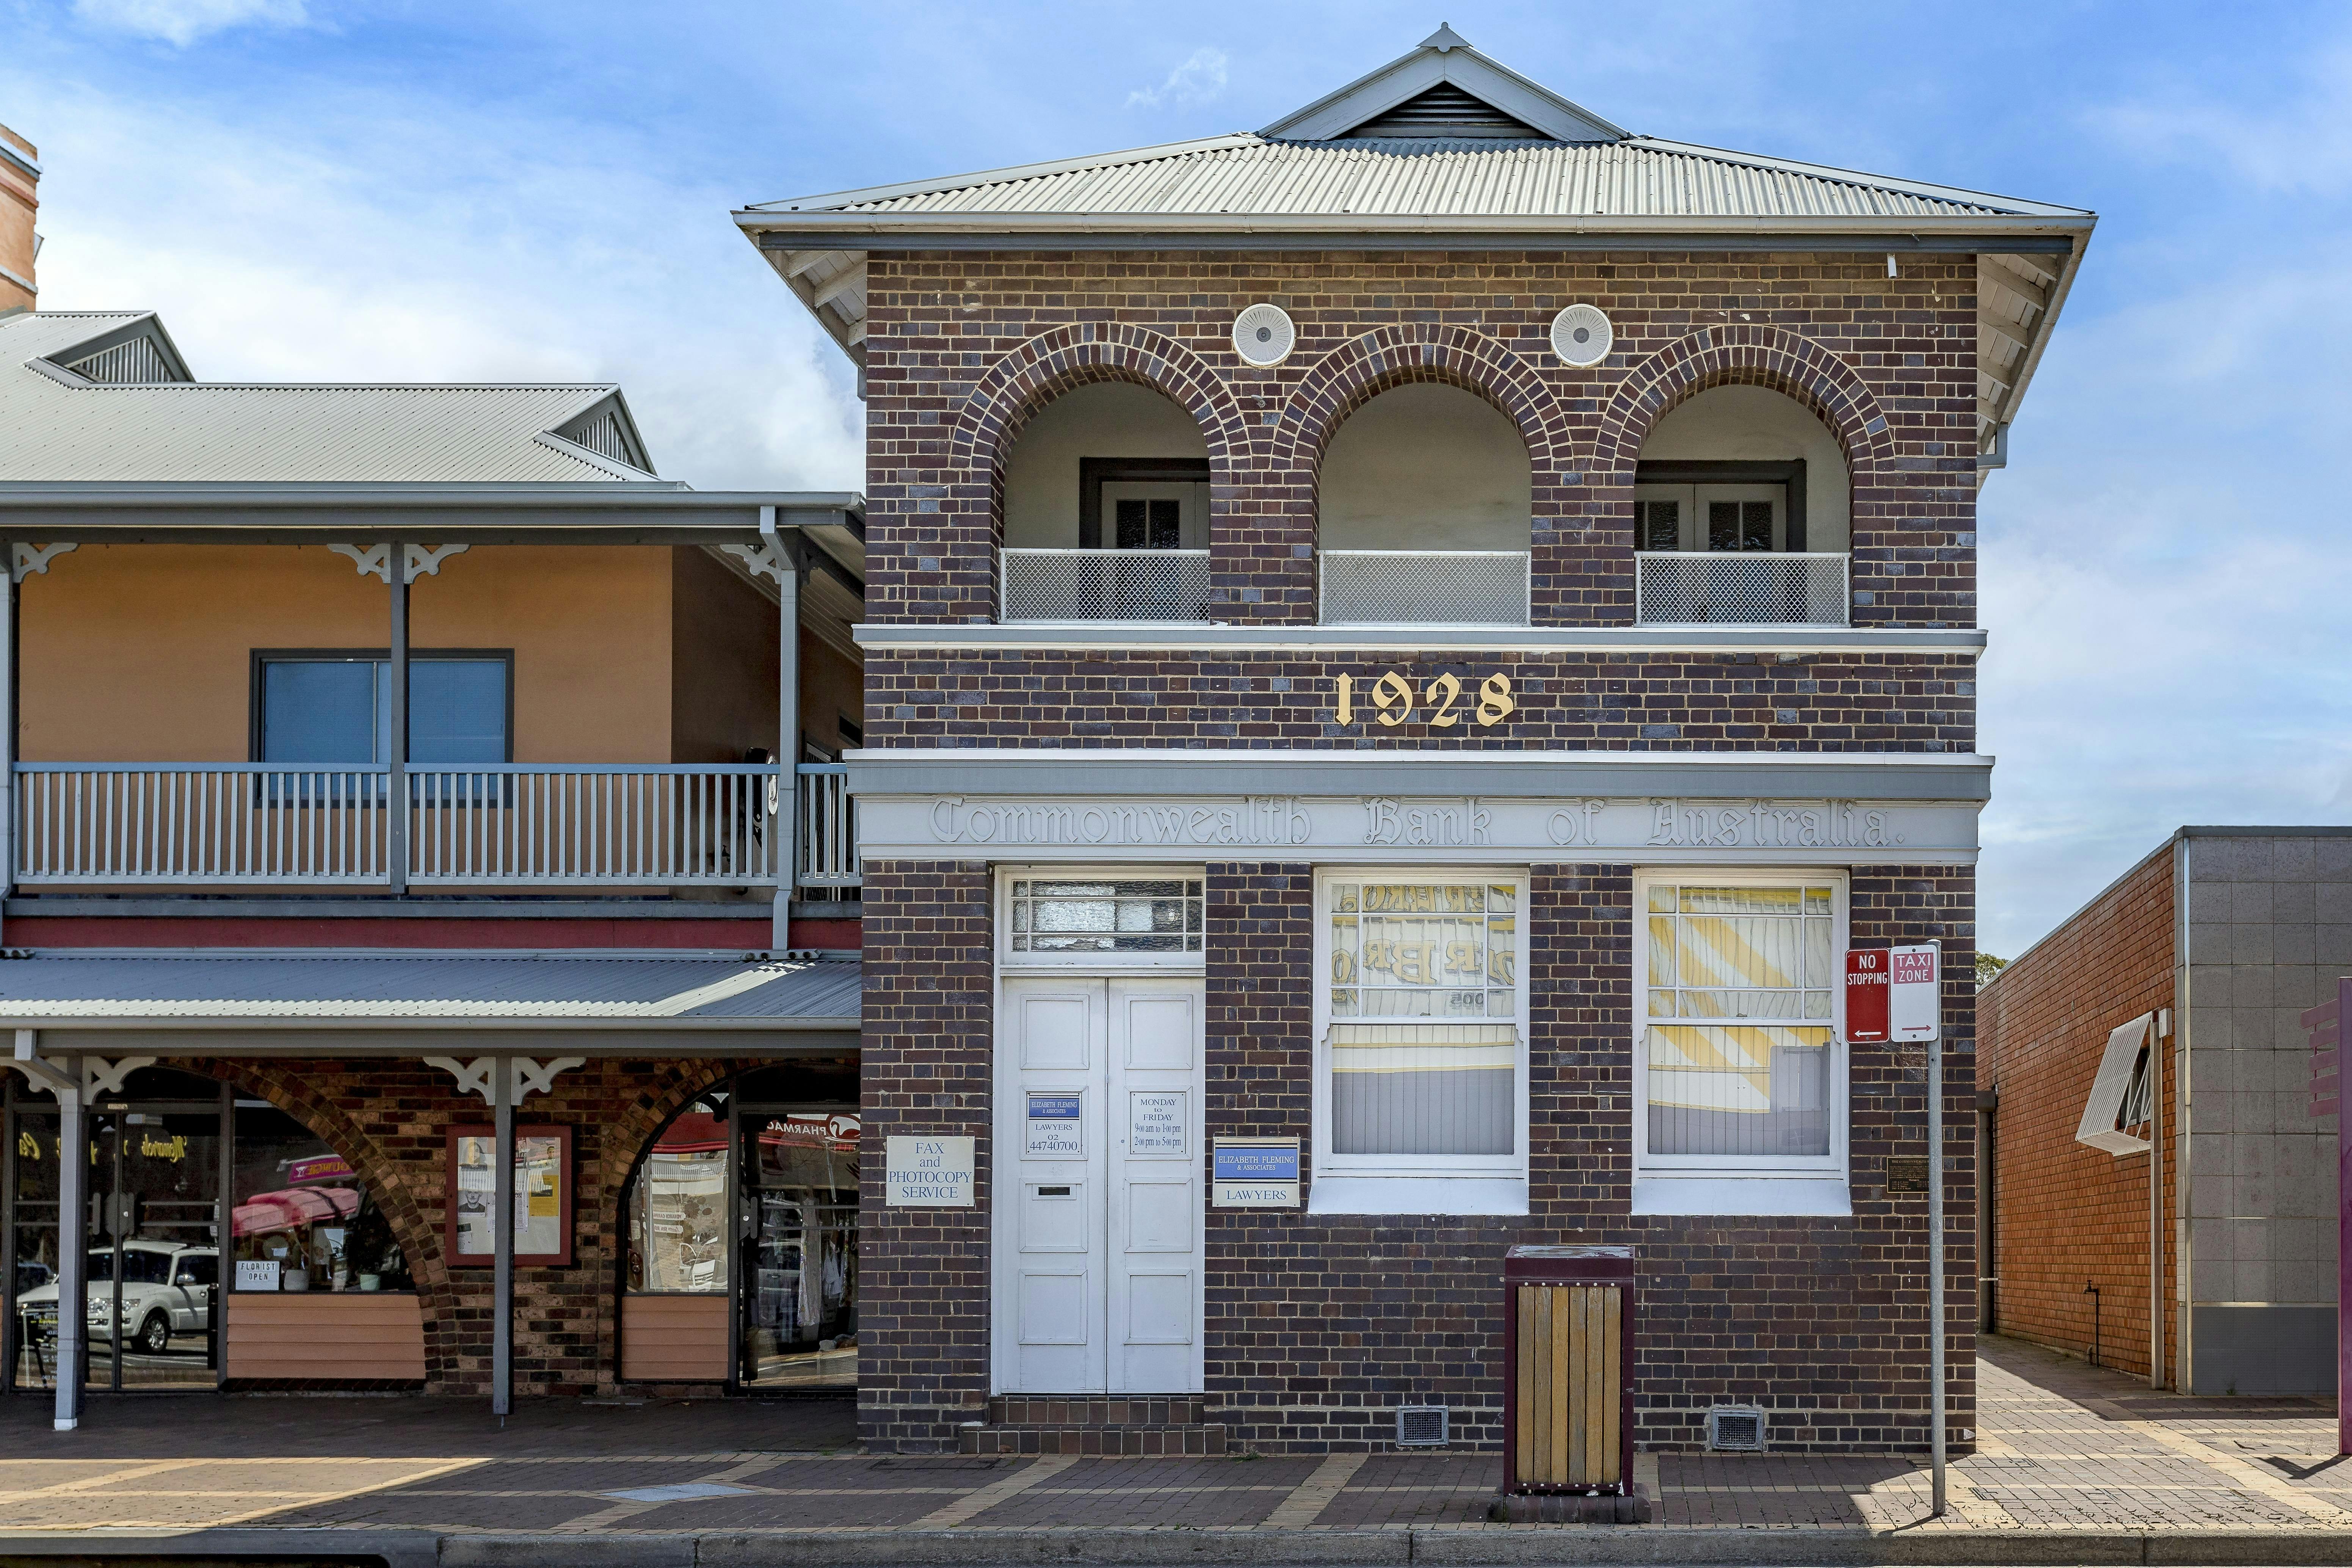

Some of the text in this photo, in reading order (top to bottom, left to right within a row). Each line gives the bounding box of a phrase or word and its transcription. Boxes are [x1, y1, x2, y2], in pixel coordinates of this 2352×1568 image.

[1334, 671, 1514, 728] 1928
[928, 795, 1312, 844] Commonwealth
[1363, 796, 1492, 845] Bank
[1548, 798, 1605, 845] of
[1859, 955, 1876, 969] NO
[1896, 954, 1930, 967] TAXI
[1847, 972, 1888, 985] STOPPING
[1899, 969, 1929, 982] ZONE
[1172, 1126, 1181, 1135] pm
[915, 1143, 945, 1154] FAX
[1029, 1141, 1077, 1151] 44740700
[1145, 1138, 1154, 1148] pm
[1173, 1138, 1181, 1149] pm
[919, 1156, 941, 1167] and
[888, 1171, 972, 1183] PHOTOCOPY
[902, 1186, 959, 1198] SERVICE
[1226, 1190, 1287, 1200] LAWYERS
